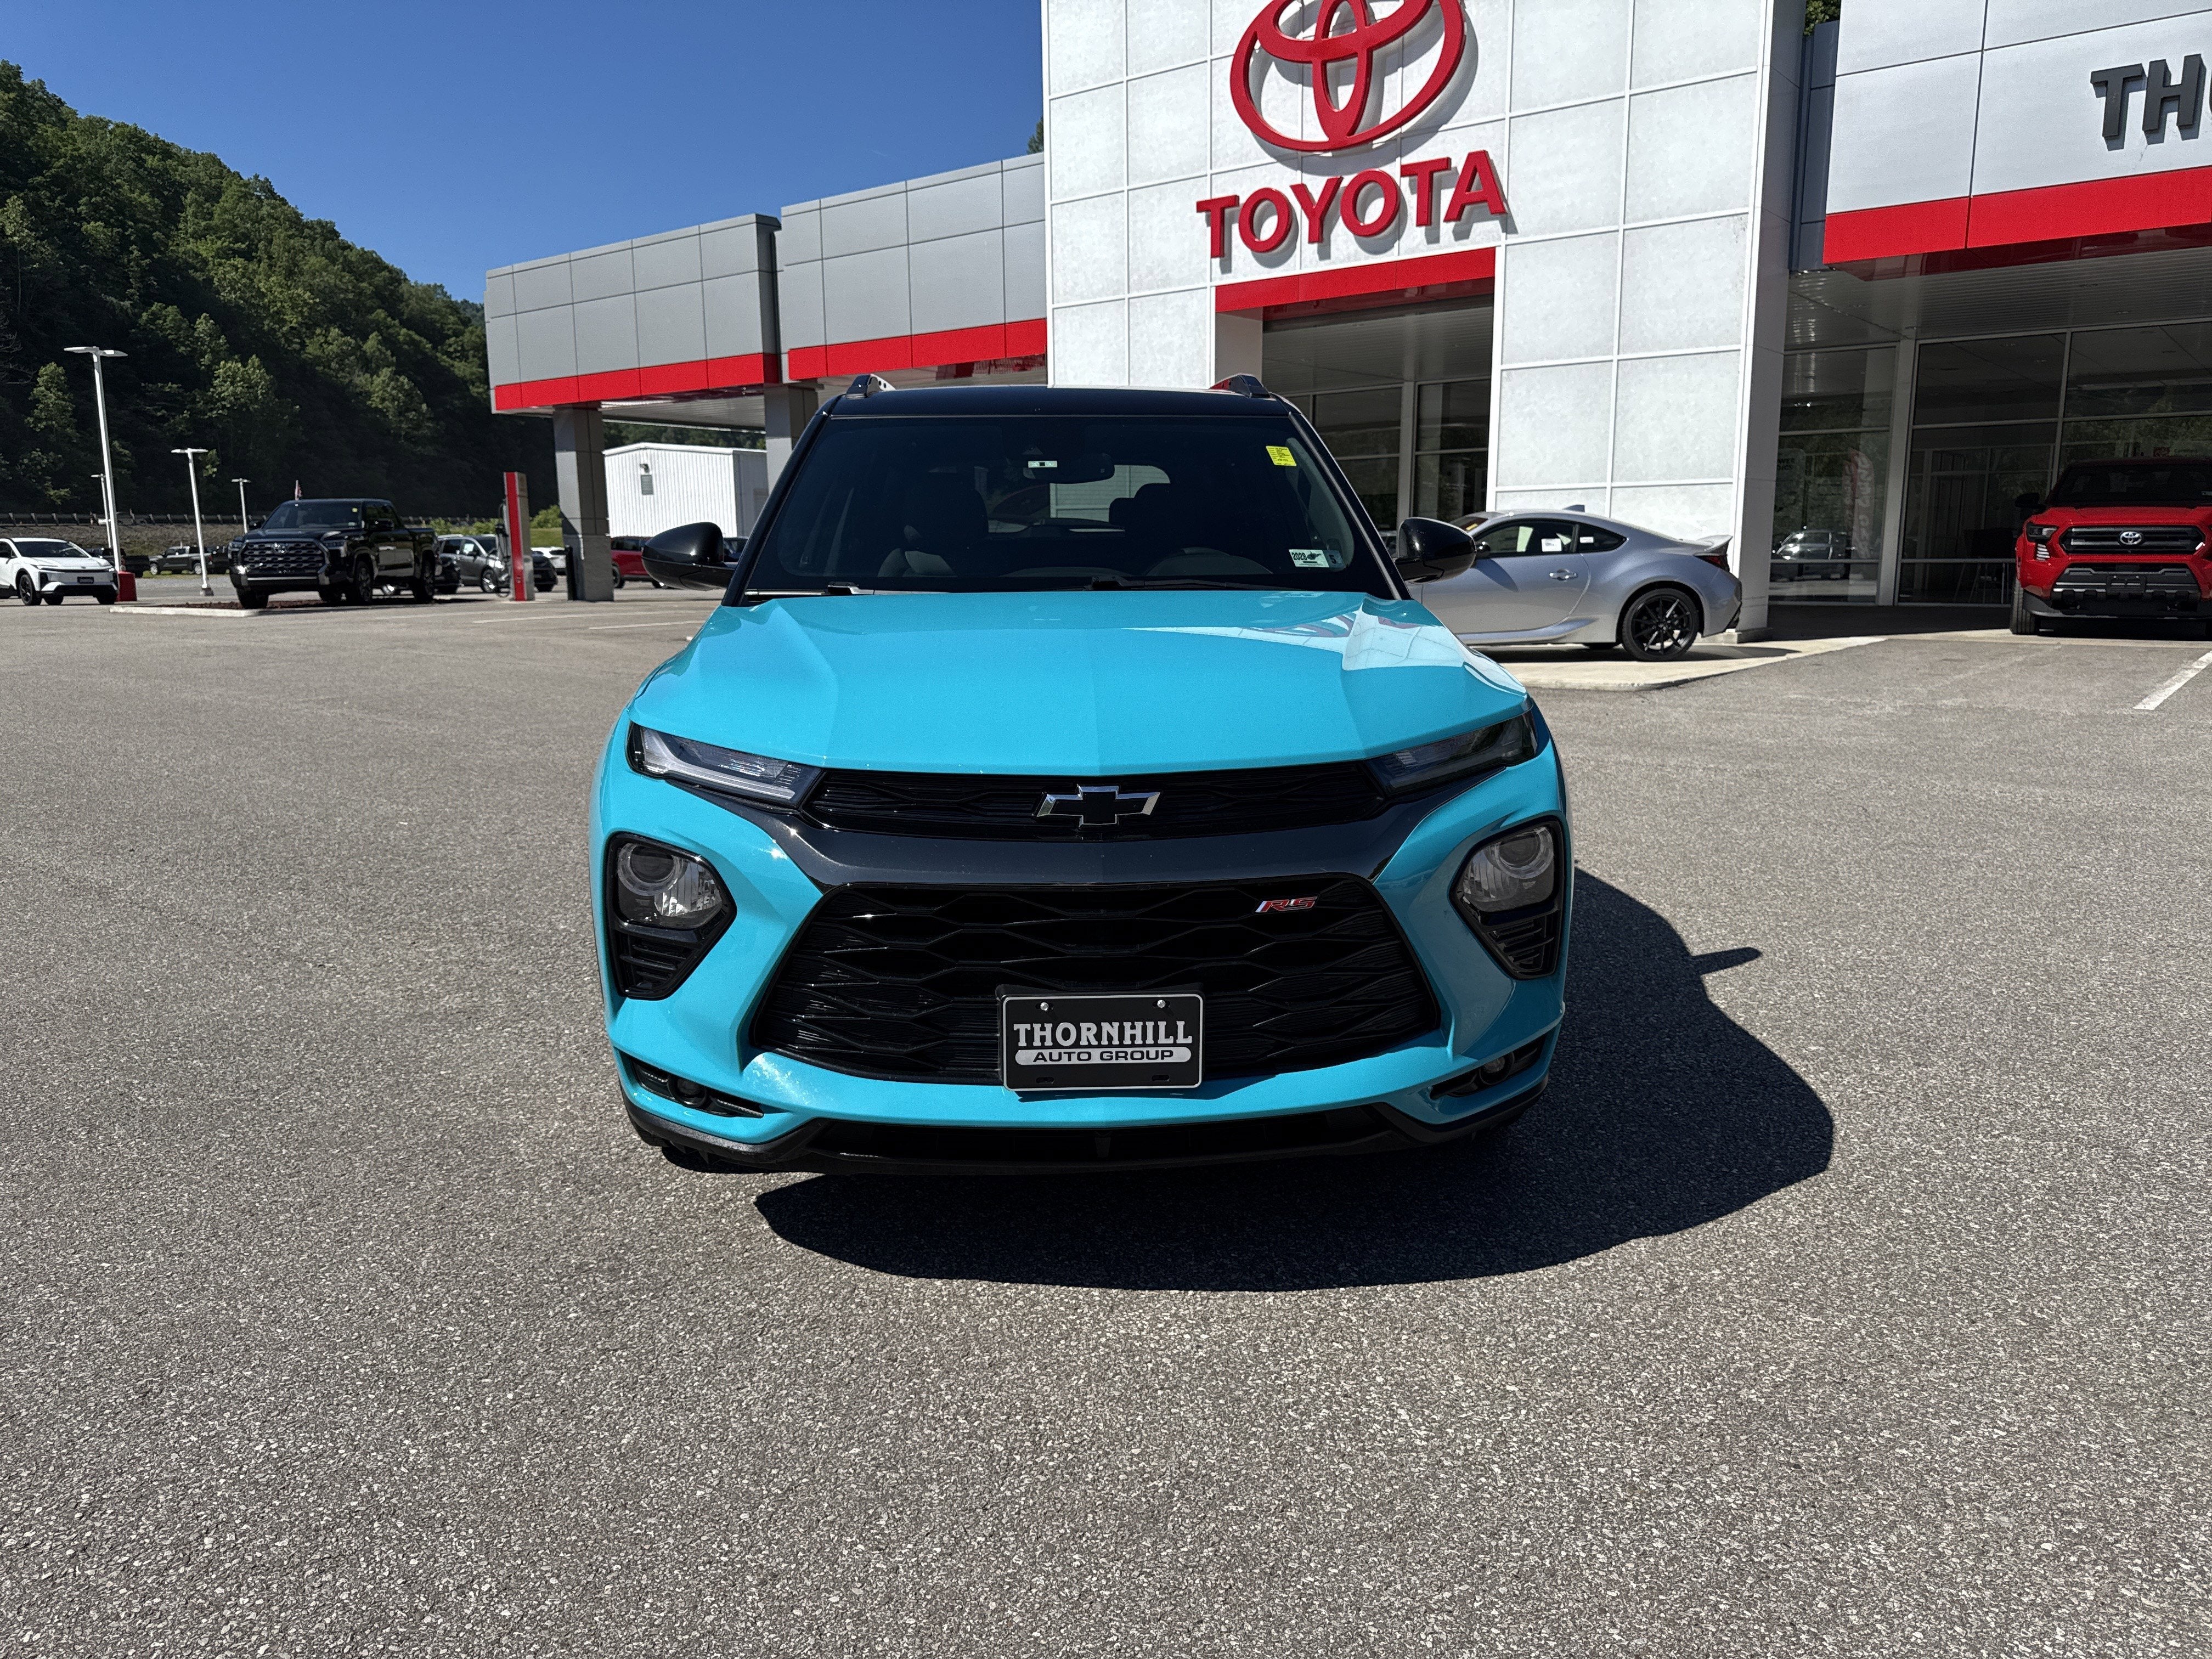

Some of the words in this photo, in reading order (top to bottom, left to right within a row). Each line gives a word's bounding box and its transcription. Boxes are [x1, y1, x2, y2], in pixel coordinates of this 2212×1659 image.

[2090, 53, 2212, 140] TH
[1197, 149, 1508, 258] TOYOTA
[1256, 896, 1318, 913] RS
[1013, 1020, 1193, 1046] THORNHILL
[1032, 1051, 1092, 1062] AUTO
[1099, 1049, 1173, 1061] GROUP
